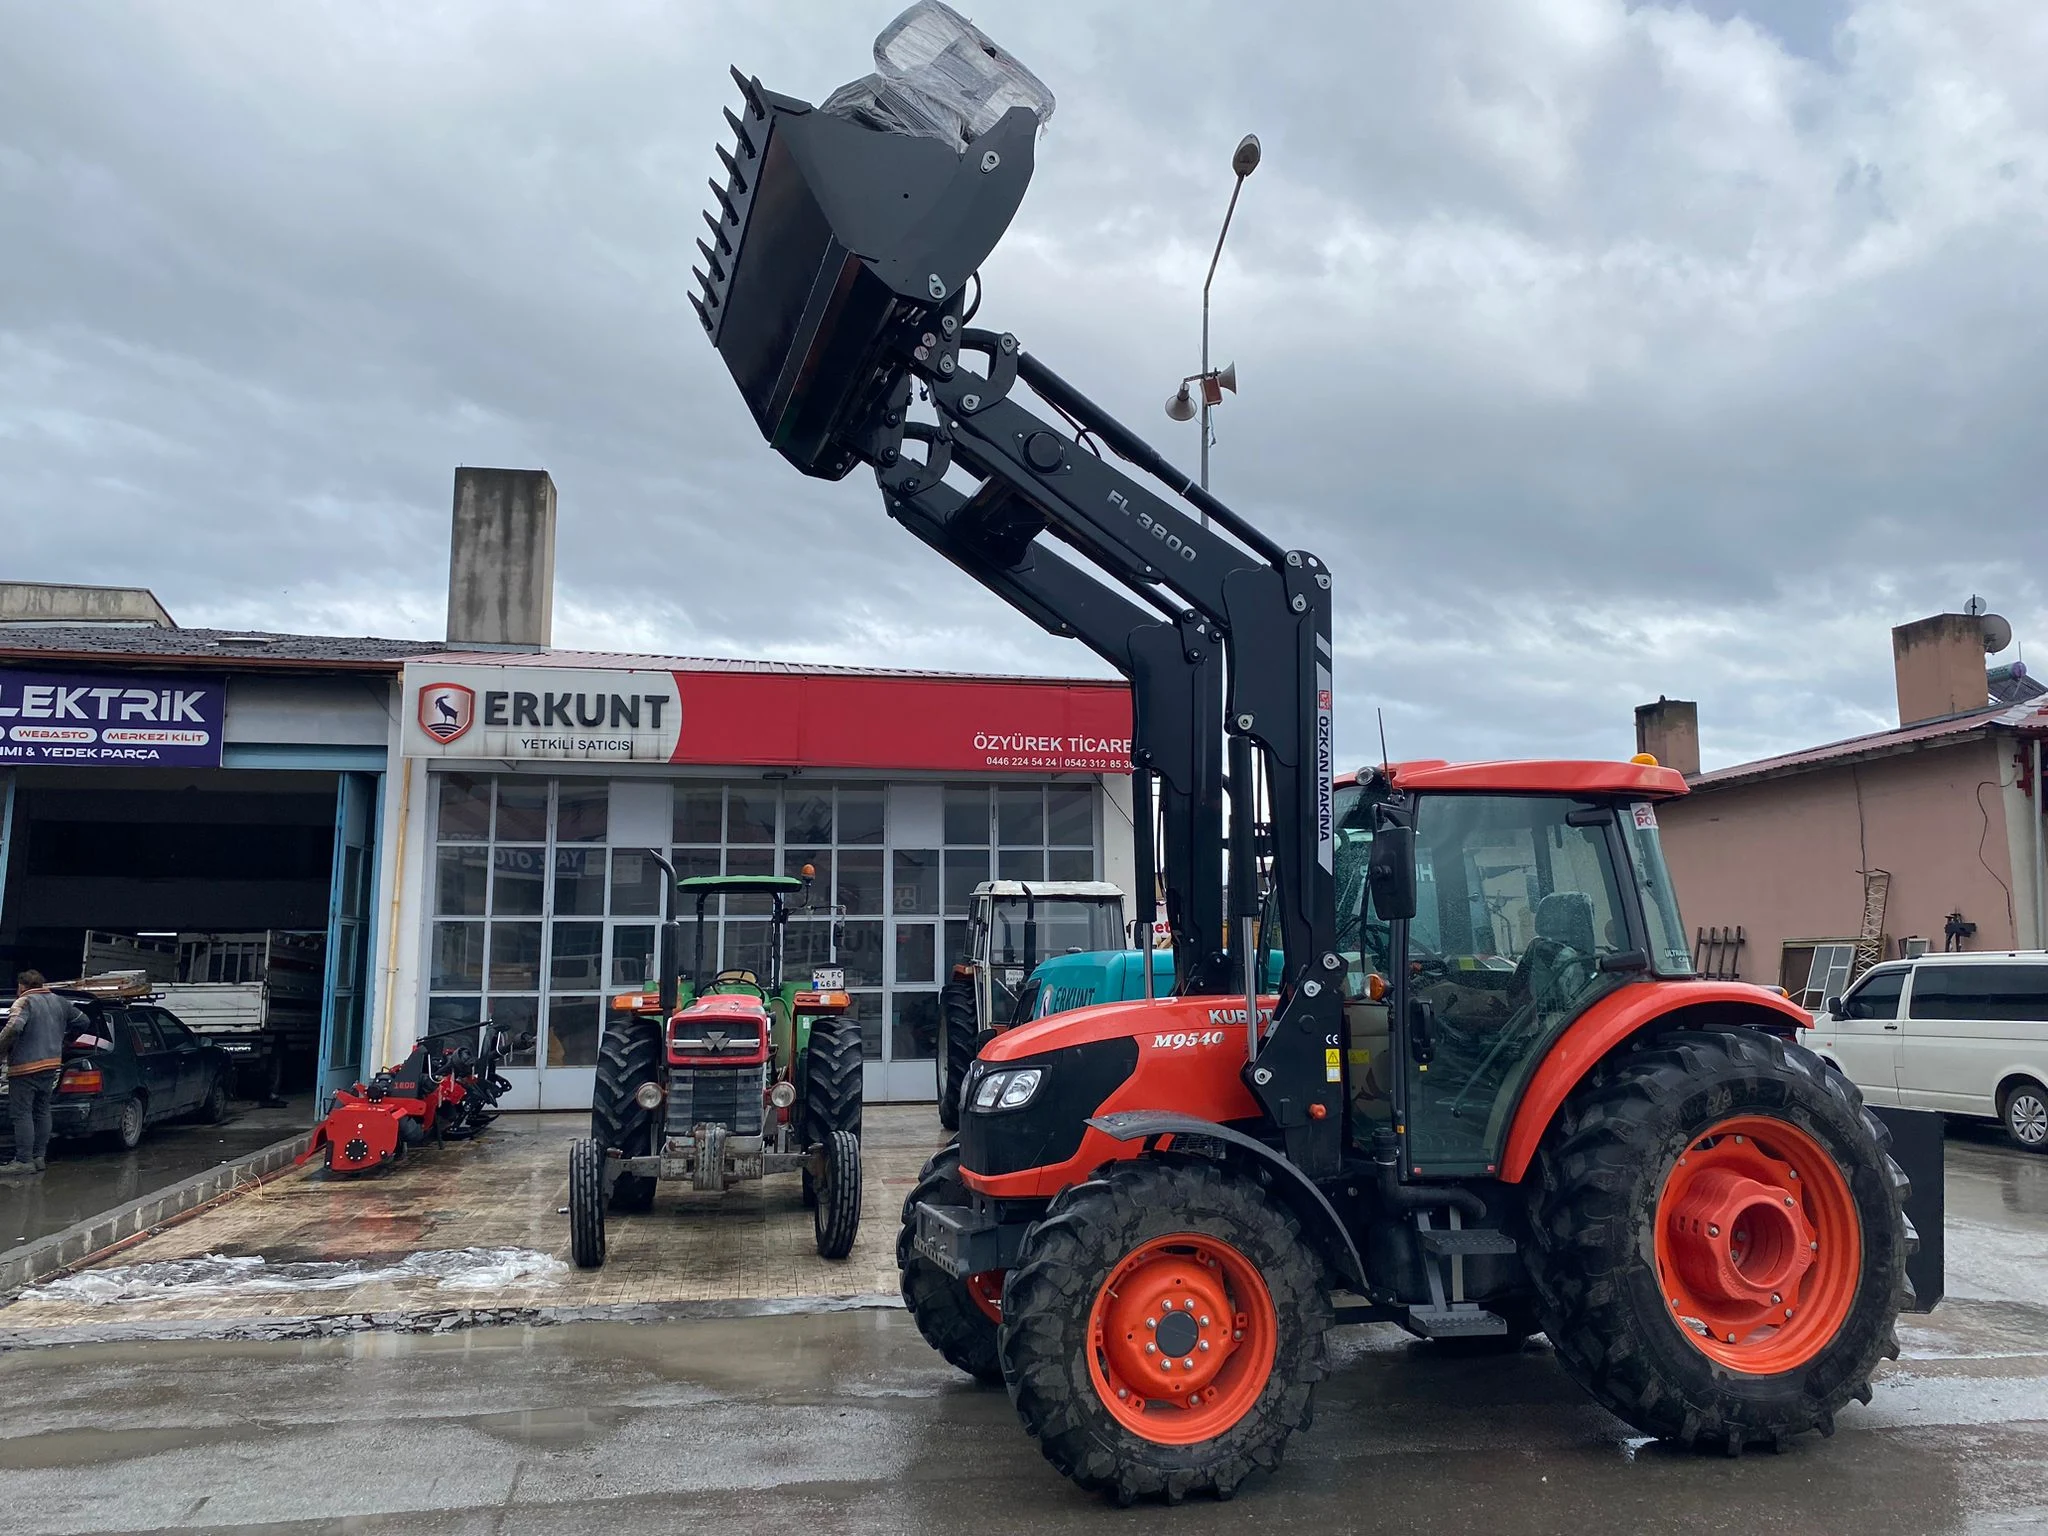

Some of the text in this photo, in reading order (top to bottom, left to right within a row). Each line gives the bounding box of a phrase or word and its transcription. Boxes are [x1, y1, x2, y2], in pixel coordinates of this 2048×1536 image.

[1106, 489, 1197, 562] FL 3800
[484, 691, 670, 729] ERKUNT
[19, 730, 89, 739] WEBASTO
[107, 731, 204, 742] MERKEZİ KİLİT
[521, 738, 634, 751] YETKİLİ SATICISI
[973, 731, 1132, 754] ÖZYÜREK TİCARE
[26, 746, 35, 756] &
[41, 747, 98, 758] YEDEK
[100, 748, 160, 760] PARÇA
[986, 756, 1009, 766] 0446
[1011, 757, 1029, 766] 224
[1031, 757, 1043, 766] 54
[1045, 758, 1057, 767] 24
[1064, 758, 1087, 767] 0542
[1089, 759, 1106, 768] 312
[1109, 760, 1121, 768] 85
[1318, 777, 1332, 842] MAKİNA
[814, 971, 825, 979] 24
[820, 980, 837, 988] 468
[1152, 1031, 1225, 1050] M9540
